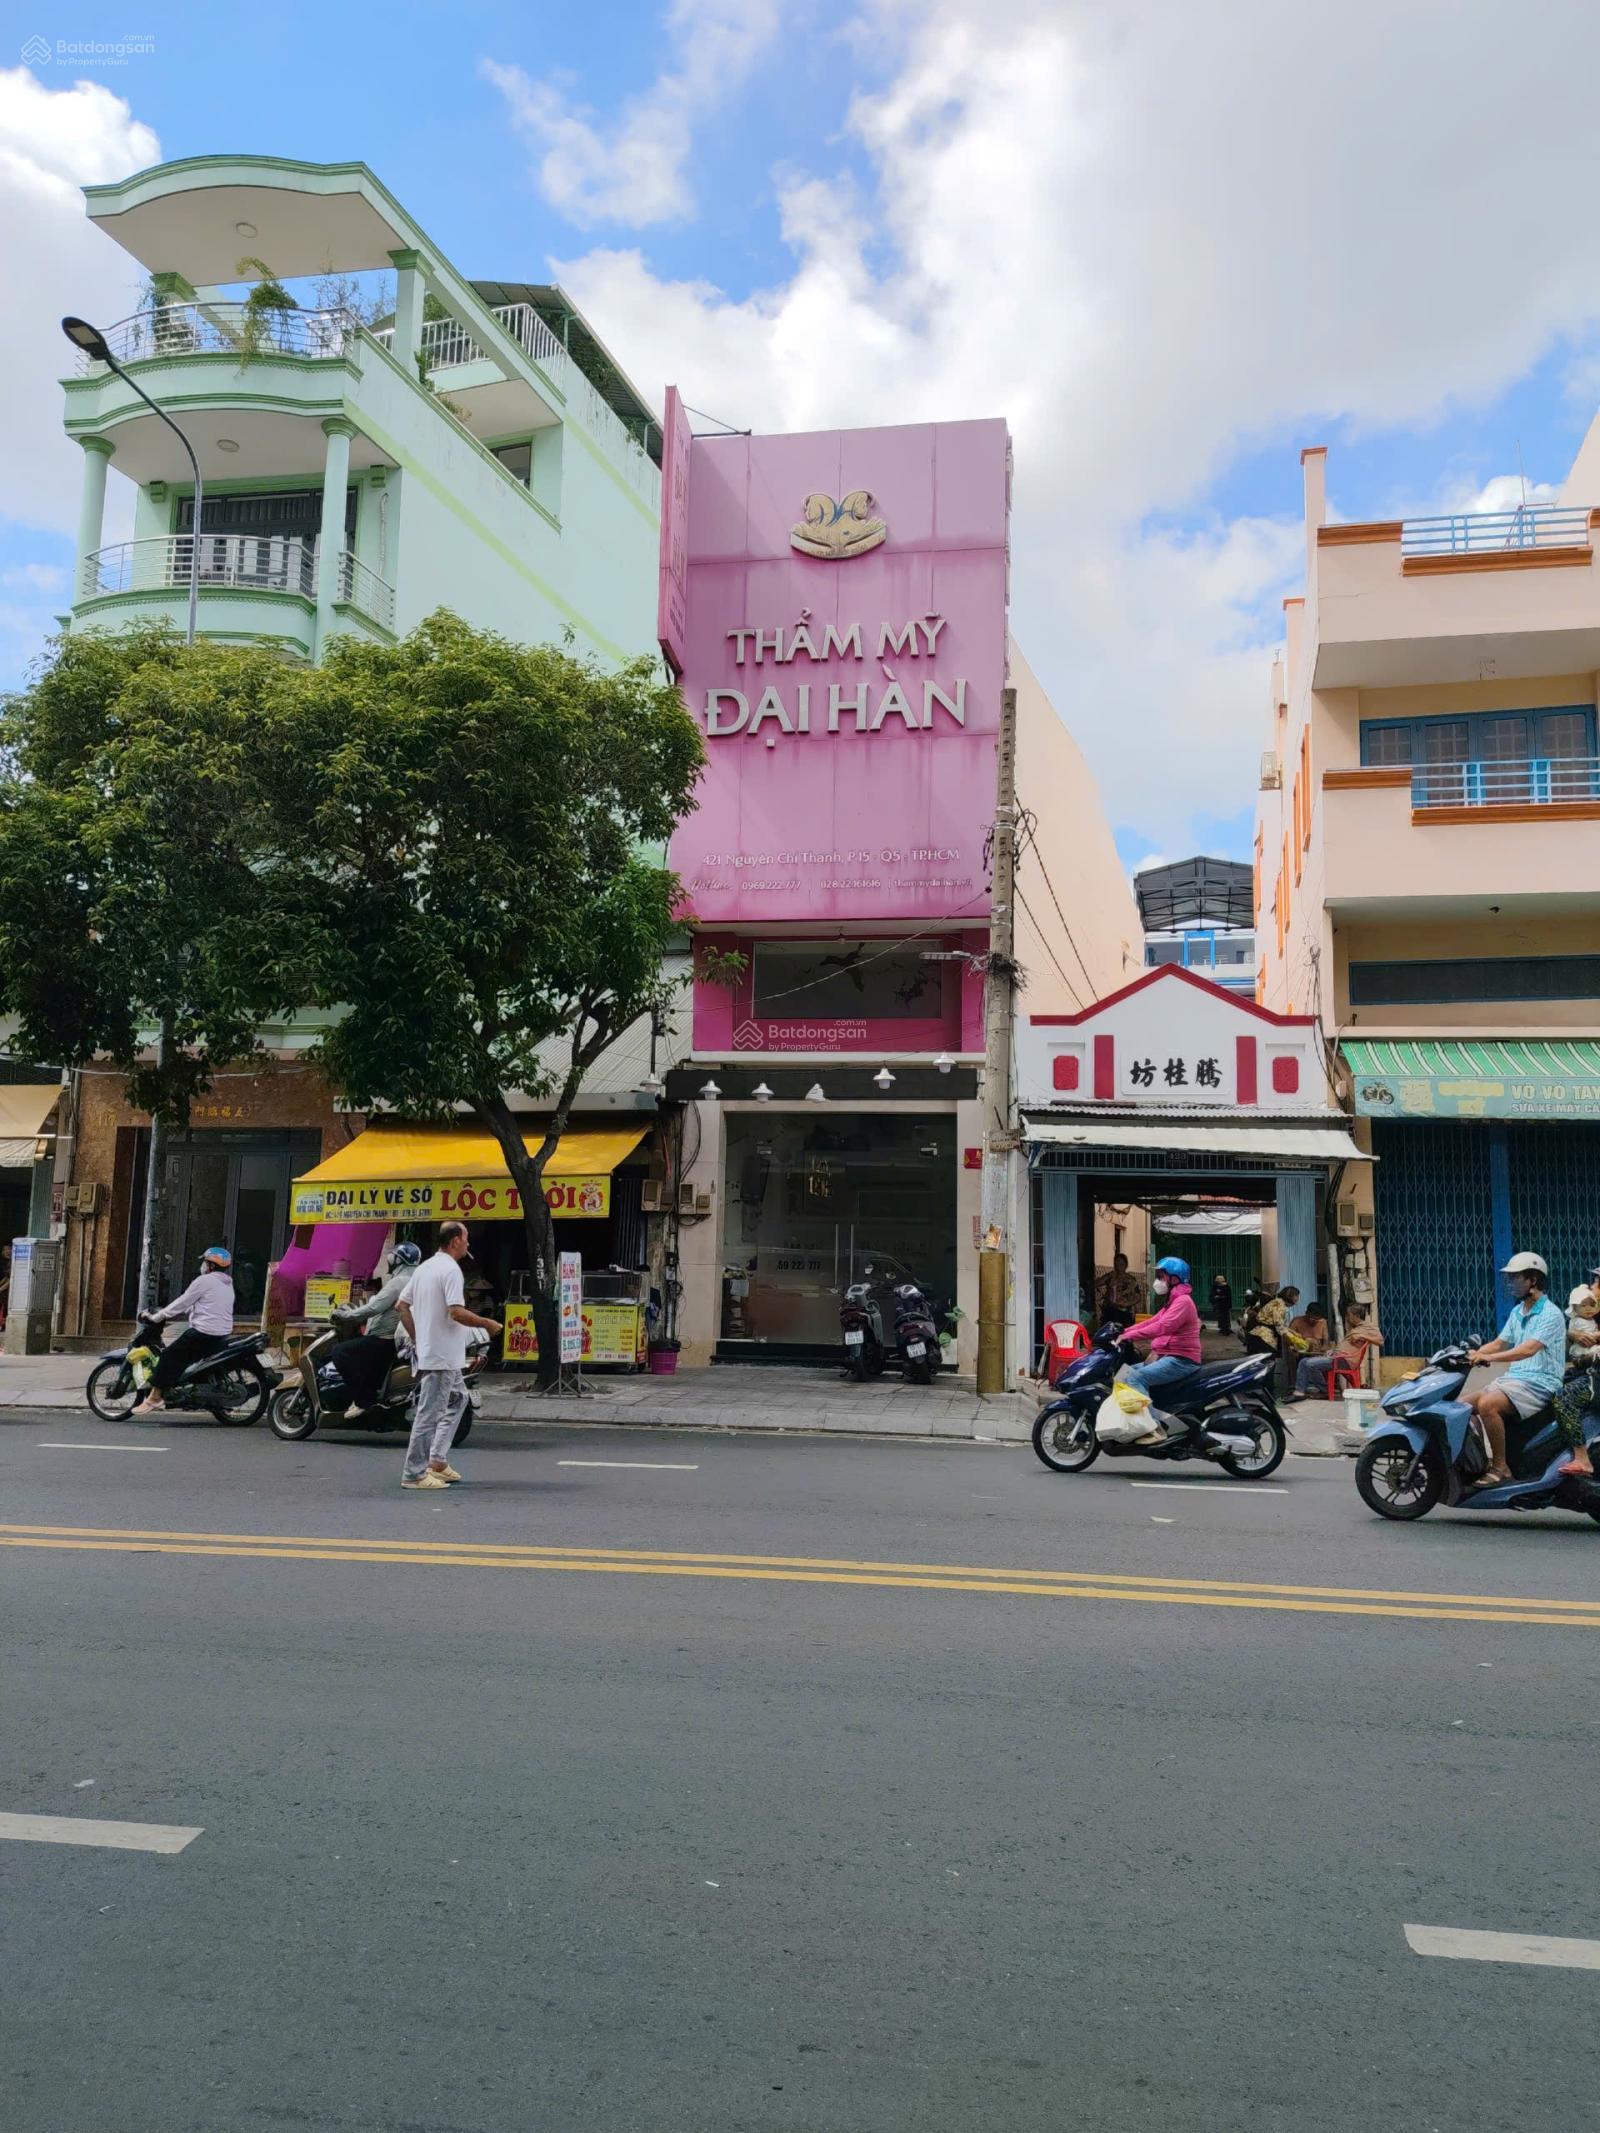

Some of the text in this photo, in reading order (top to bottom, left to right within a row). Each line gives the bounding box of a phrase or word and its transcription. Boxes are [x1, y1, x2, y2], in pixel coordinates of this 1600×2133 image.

[727, 607, 863, 665] THẨM
[876, 610, 947, 659] MỸ
[704, 664, 968, 750] ĐẠI HÀN
[703, 854, 721, 866] 421
[1538, 1103, 1553, 1113] XE
[326, 1190, 354, 1208] ĐẠI
[359, 1186, 378, 1204] LÝ
[384, 1185, 404, 1203] VÉ
[410, 1183, 433, 1203] SỐ
[440, 1182, 497, 1217] LỘC
[505, 1180, 577, 1210] TỜI
